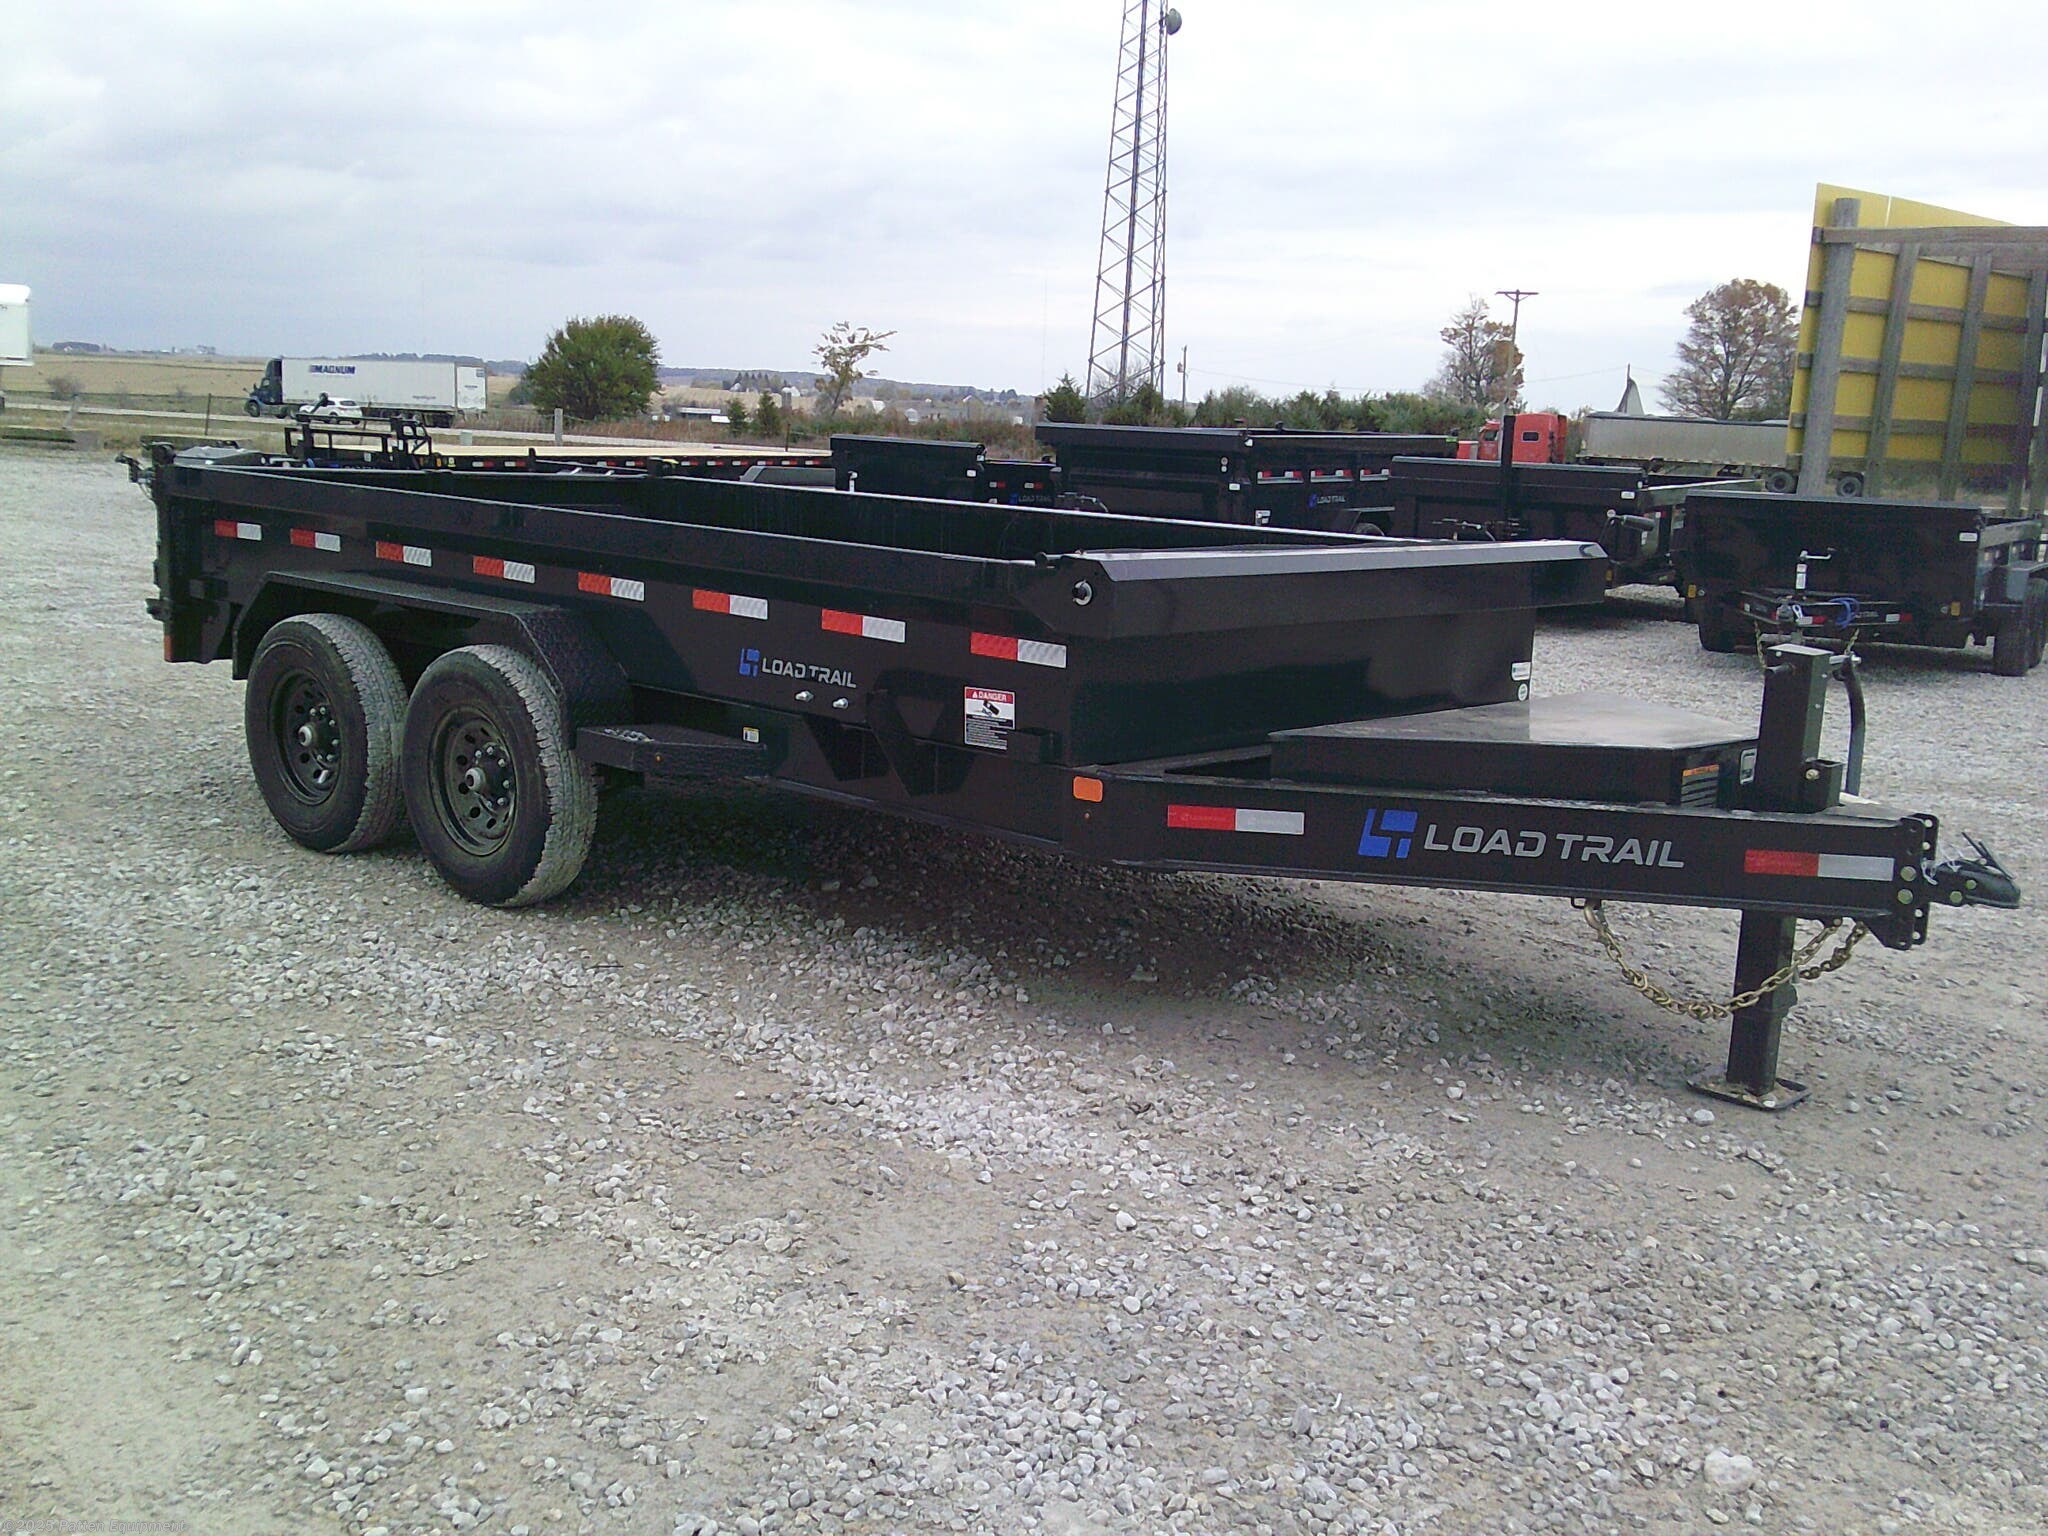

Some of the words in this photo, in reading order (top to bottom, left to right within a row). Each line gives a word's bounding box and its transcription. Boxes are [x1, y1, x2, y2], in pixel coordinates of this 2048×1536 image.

[312, 365, 356, 374] MAGNUM
[762, 657, 806, 678] LOAD
[809, 665, 857, 688] TRAIL
[978, 691, 1007, 702] DANGER
[1424, 824, 1547, 857] LOAD
[1555, 833, 1685, 868] TRAIL
